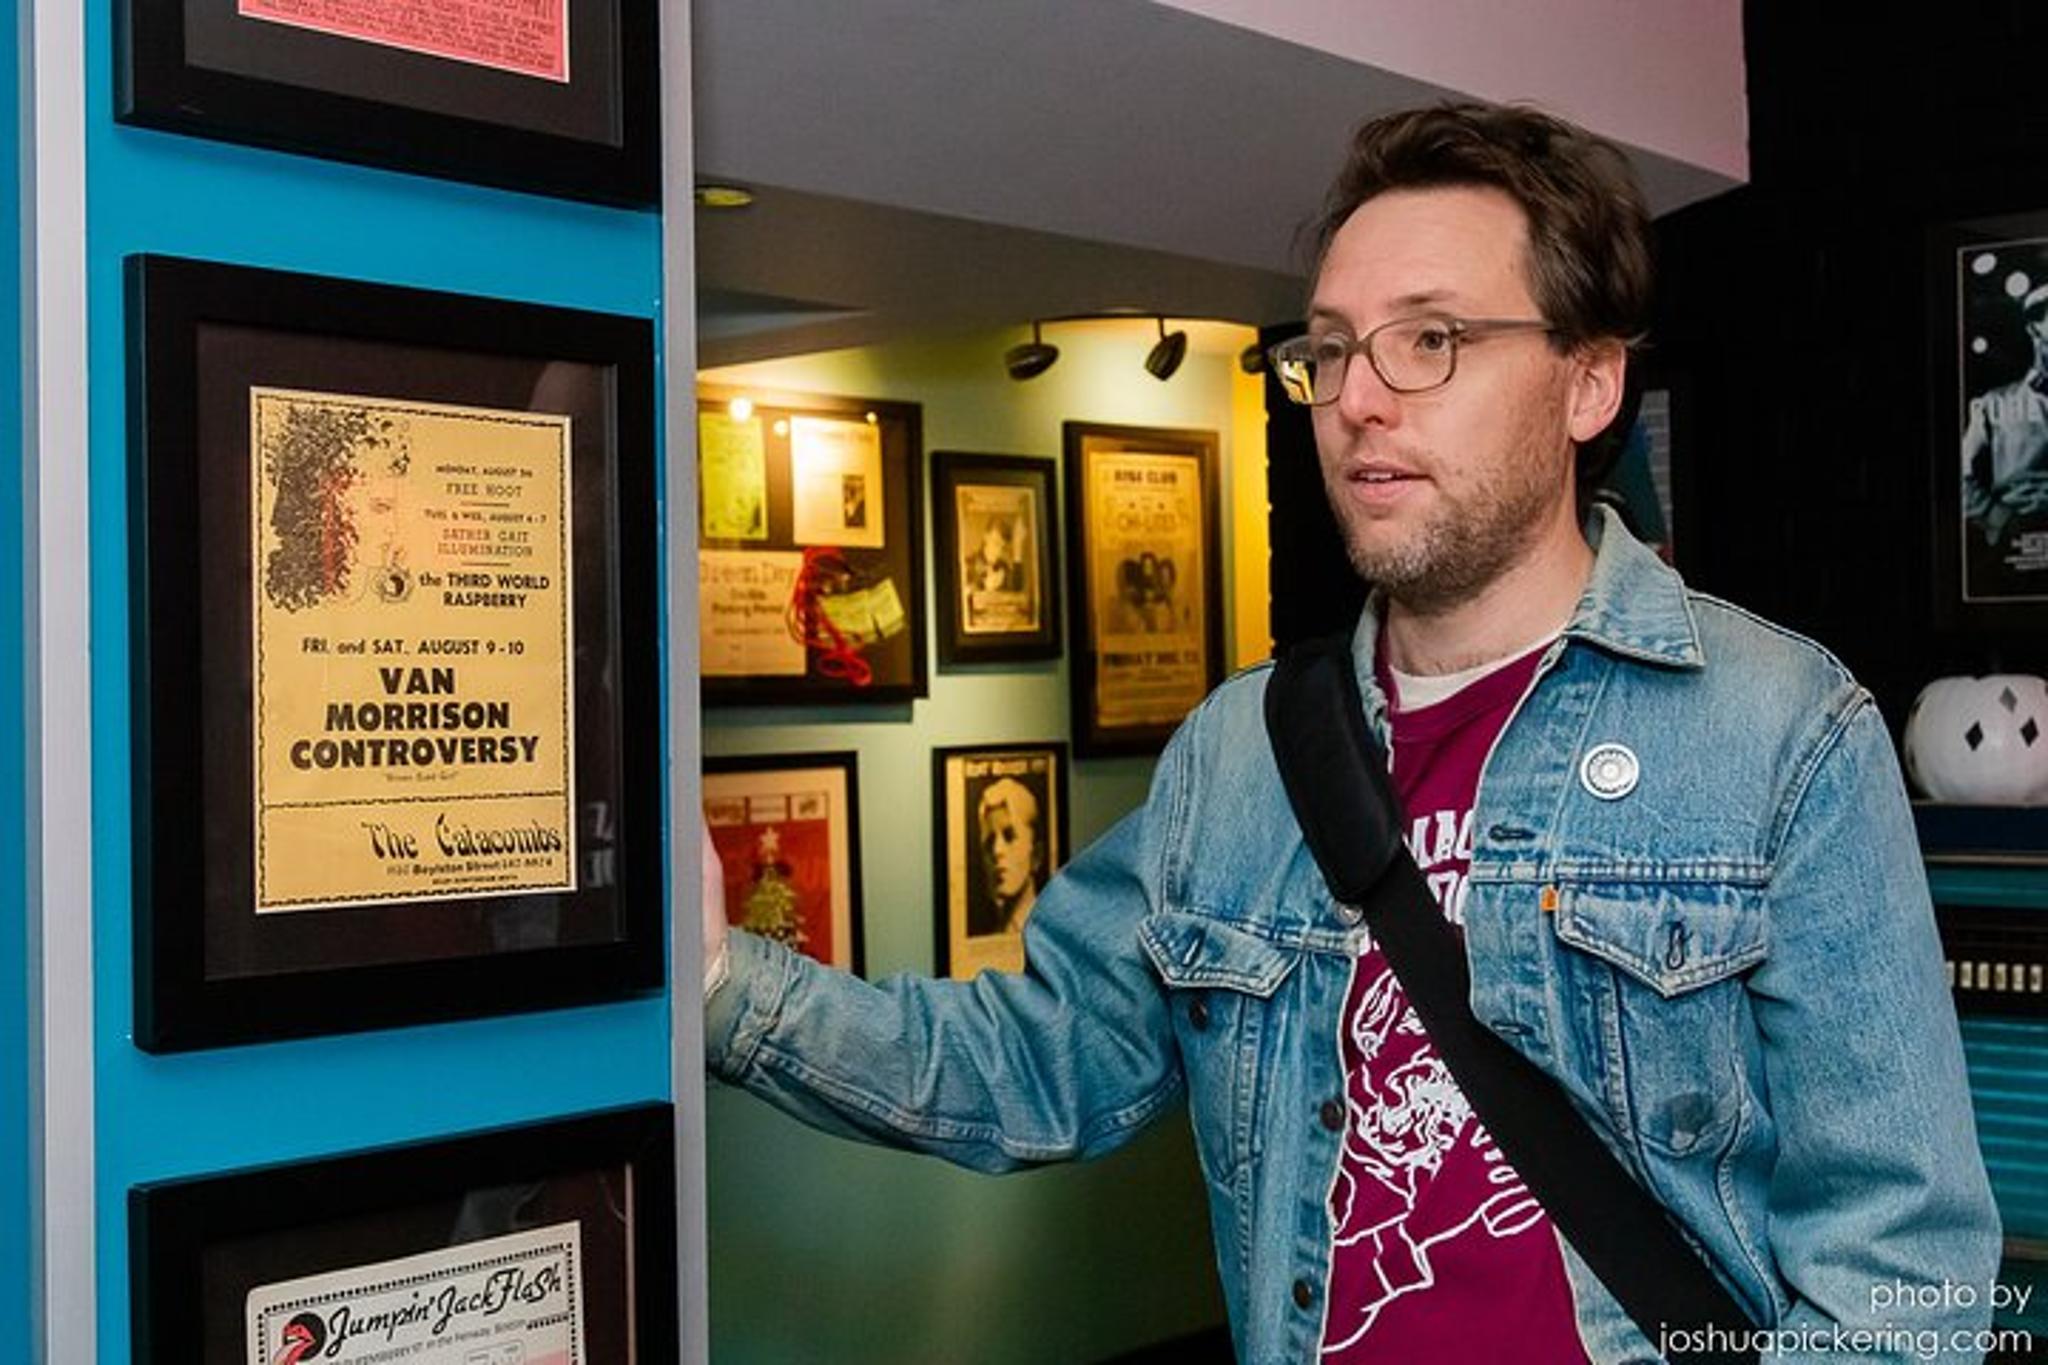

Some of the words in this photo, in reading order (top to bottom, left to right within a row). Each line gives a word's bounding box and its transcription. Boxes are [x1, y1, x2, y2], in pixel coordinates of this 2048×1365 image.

[446, 483, 479, 496] FREE
[486, 484, 523, 498] HOOT
[437, 542, 533, 557] ILLUMINATION
[419, 572, 442, 587] the
[447, 573, 492, 588] THIRD
[496, 574, 550, 590] WORLD
[443, 591, 527, 608] RASPBERRY
[338, 639, 367, 655] and
[418, 639, 480, 656] AUGUST
[379, 667, 455, 695] VAN
[324, 701, 510, 732] MORRISON
[289, 735, 539, 771] CONTROVERSY
[361, 820, 419, 860] The
[435, 812, 562, 858] Catacombs
[324, 1290, 436, 1358] Jumpin'
[432, 1278, 496, 1335] Jack
